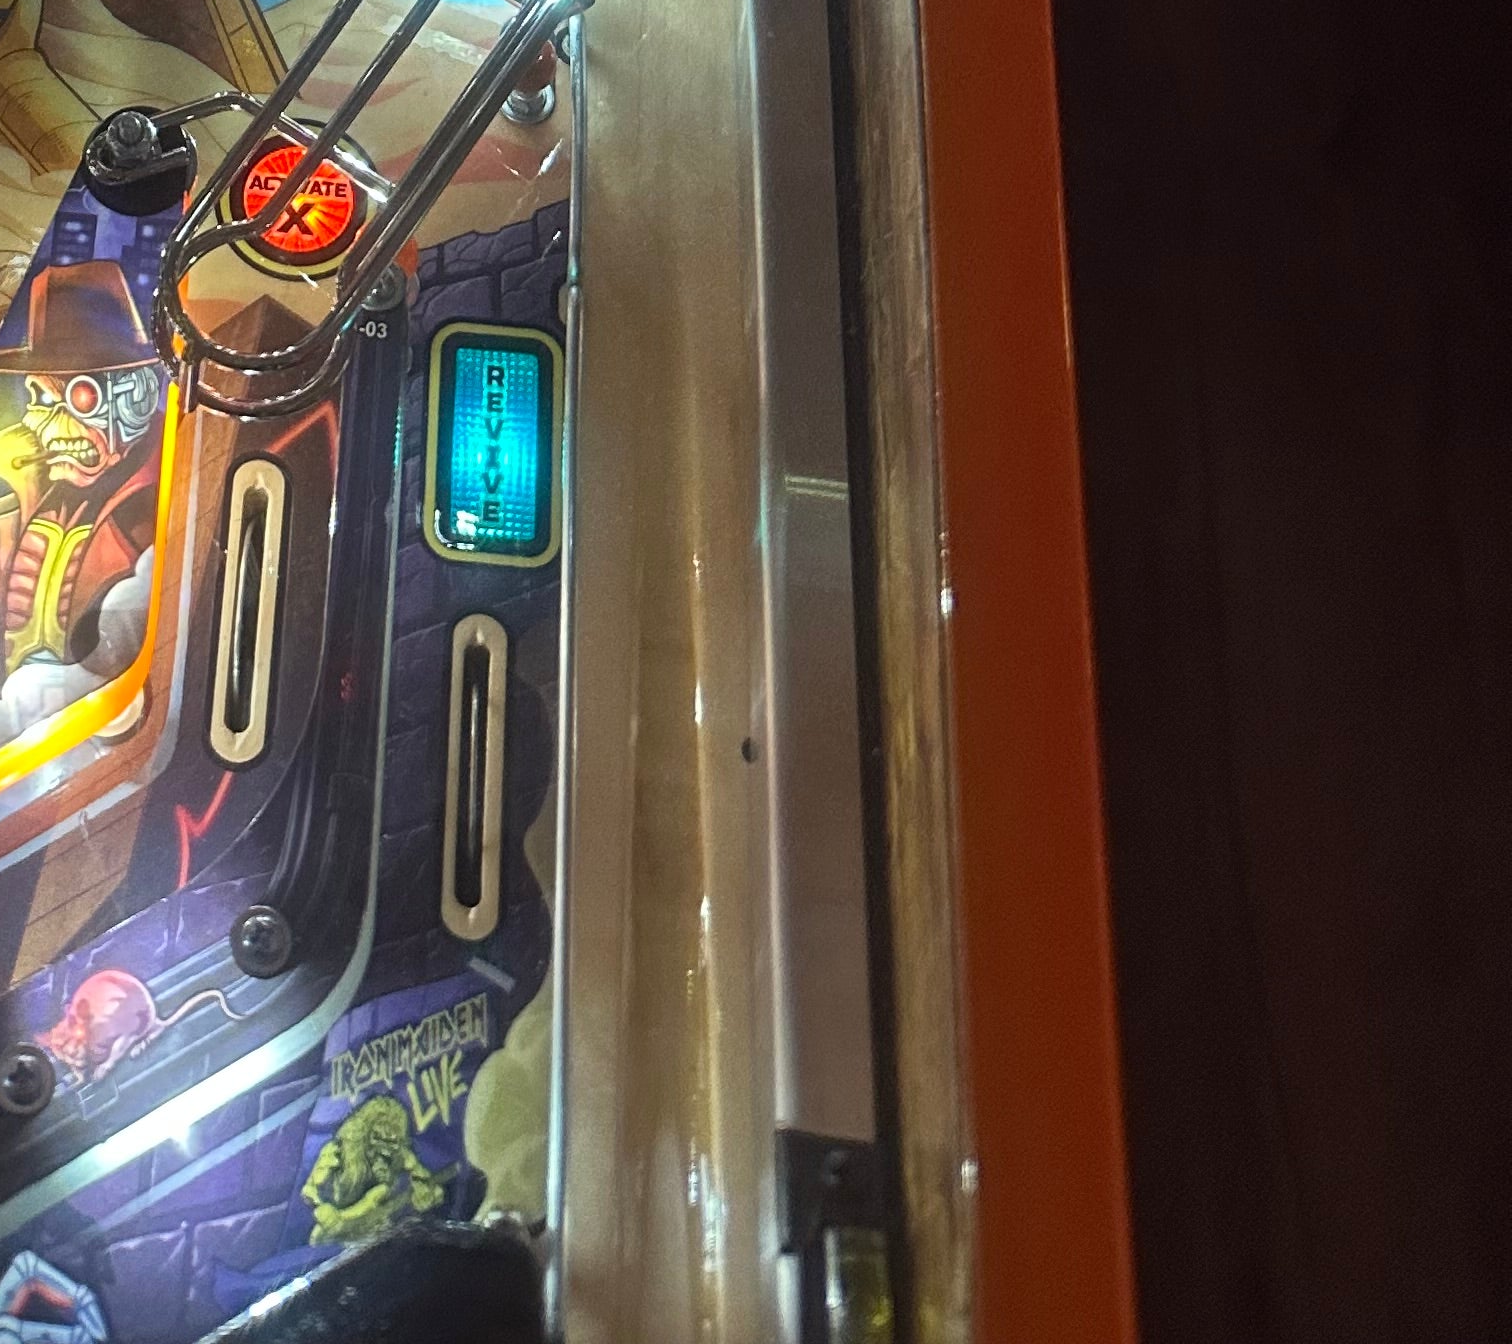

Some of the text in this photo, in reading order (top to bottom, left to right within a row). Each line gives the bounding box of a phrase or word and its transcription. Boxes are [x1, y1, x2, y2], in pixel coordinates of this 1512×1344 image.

[249, 175, 348, 198] ACATE
[276, 202, 316, 236] X
[481, 364, 506, 523] REVIVE
[331, 991, 488, 1104] IRON MAIDEN
[406, 1048, 469, 1134] LIVE
